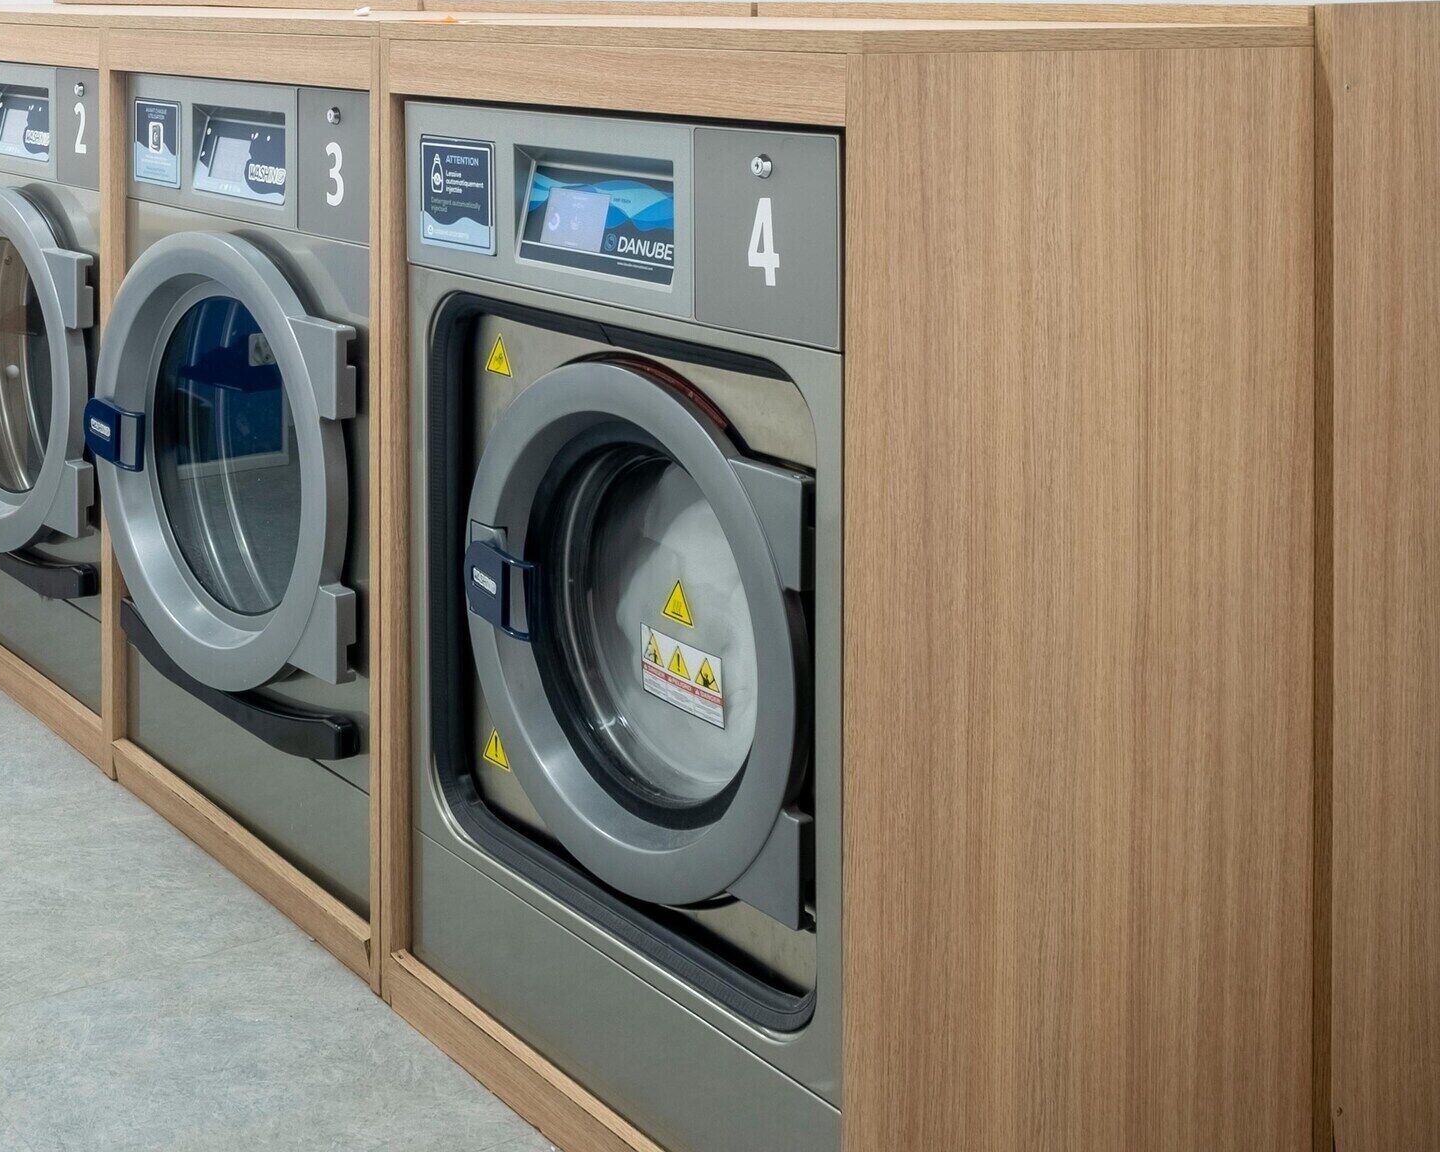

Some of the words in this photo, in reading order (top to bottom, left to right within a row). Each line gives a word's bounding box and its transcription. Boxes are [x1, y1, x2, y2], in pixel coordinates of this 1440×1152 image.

[74, 102, 87, 154] 2
[325, 142, 345, 207] 3
[445, 154, 479, 167] ATTENTION
[617, 236, 674, 261] DANUBE
[748, 197, 780, 287] 4
